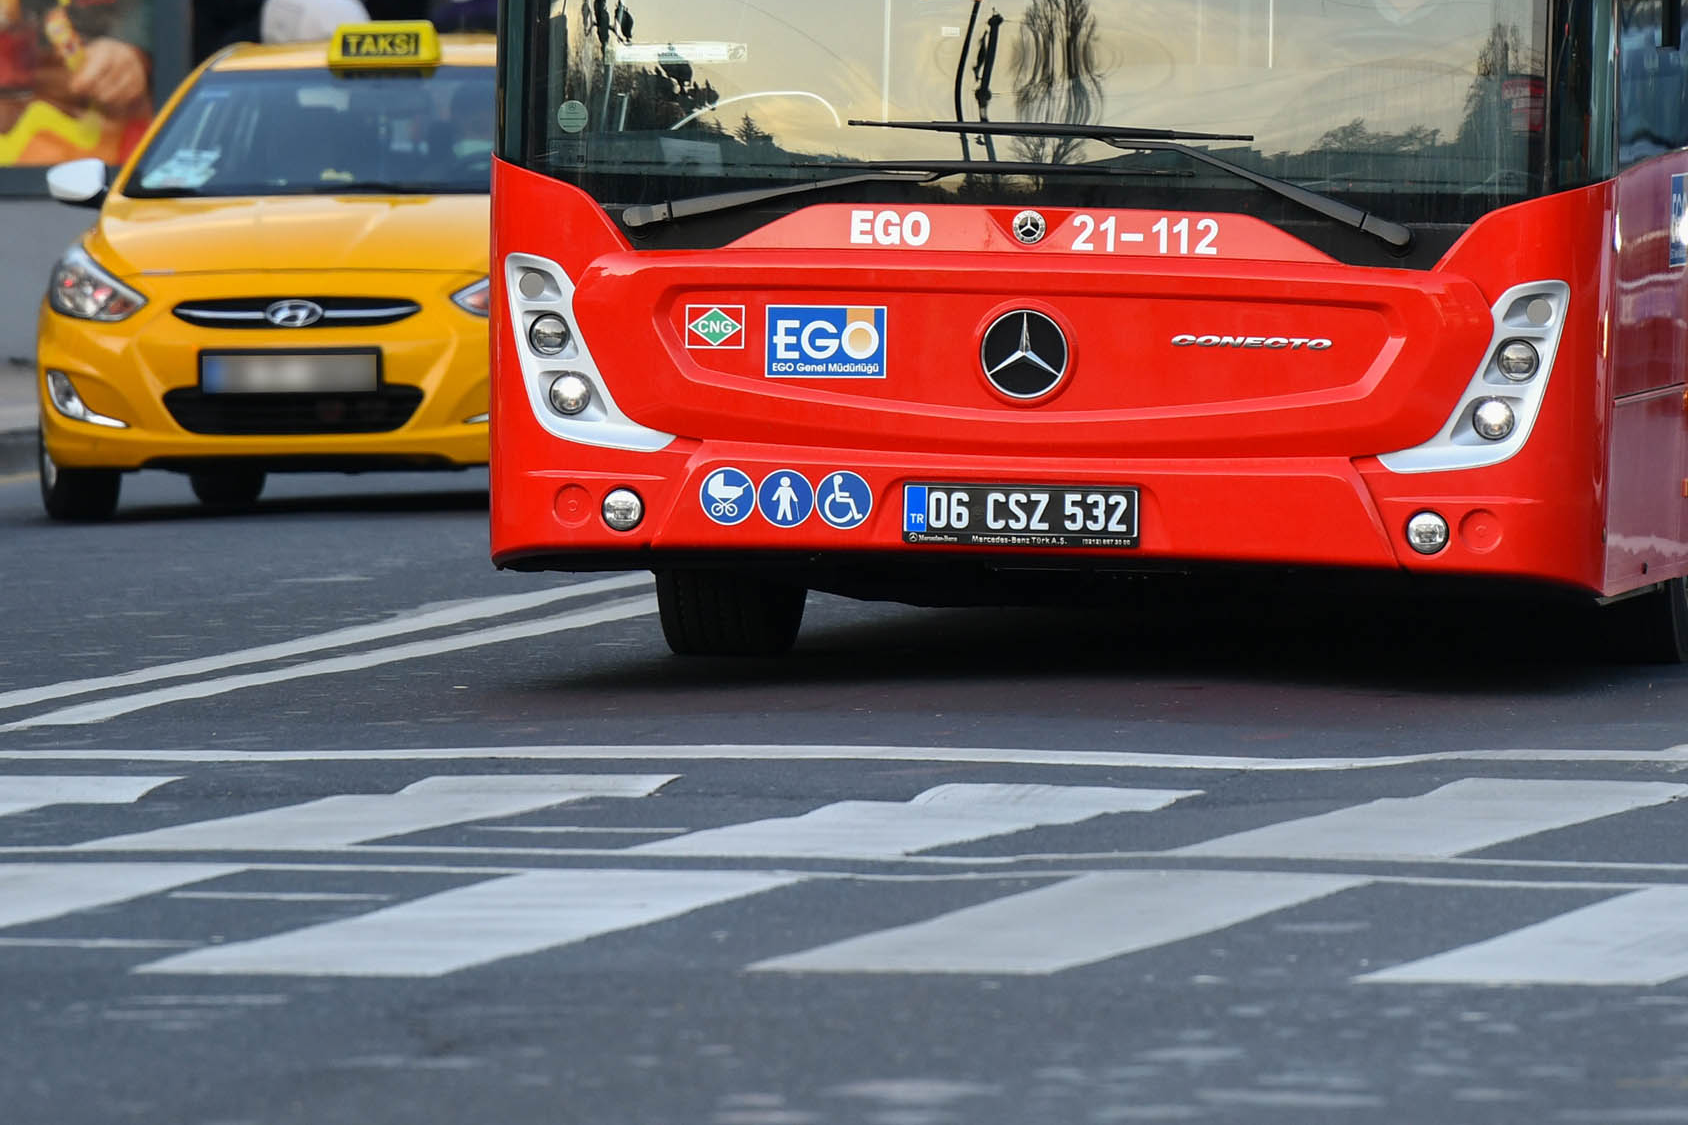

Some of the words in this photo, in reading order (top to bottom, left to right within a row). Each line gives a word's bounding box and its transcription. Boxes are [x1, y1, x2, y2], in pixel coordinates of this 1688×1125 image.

[850, 210, 931, 246] EGO
[1071, 214, 1219, 255] 21-112
[698, 320, 732, 334] CNG
[773, 320, 880, 360] EGO
[1171, 334, 1333, 350] CONECTO
[772, 362, 795, 372] EGO
[796, 363, 827, 373] Genel
[828, 363, 880, 375] Müdürlüğü
[910, 513, 925, 524] TR
[929, 491, 970, 529] 06
[986, 493, 1050, 530] CSZ
[1064, 493, 1128, 532] 532
[971, 535, 1031, 544] Mercedes-Benz
